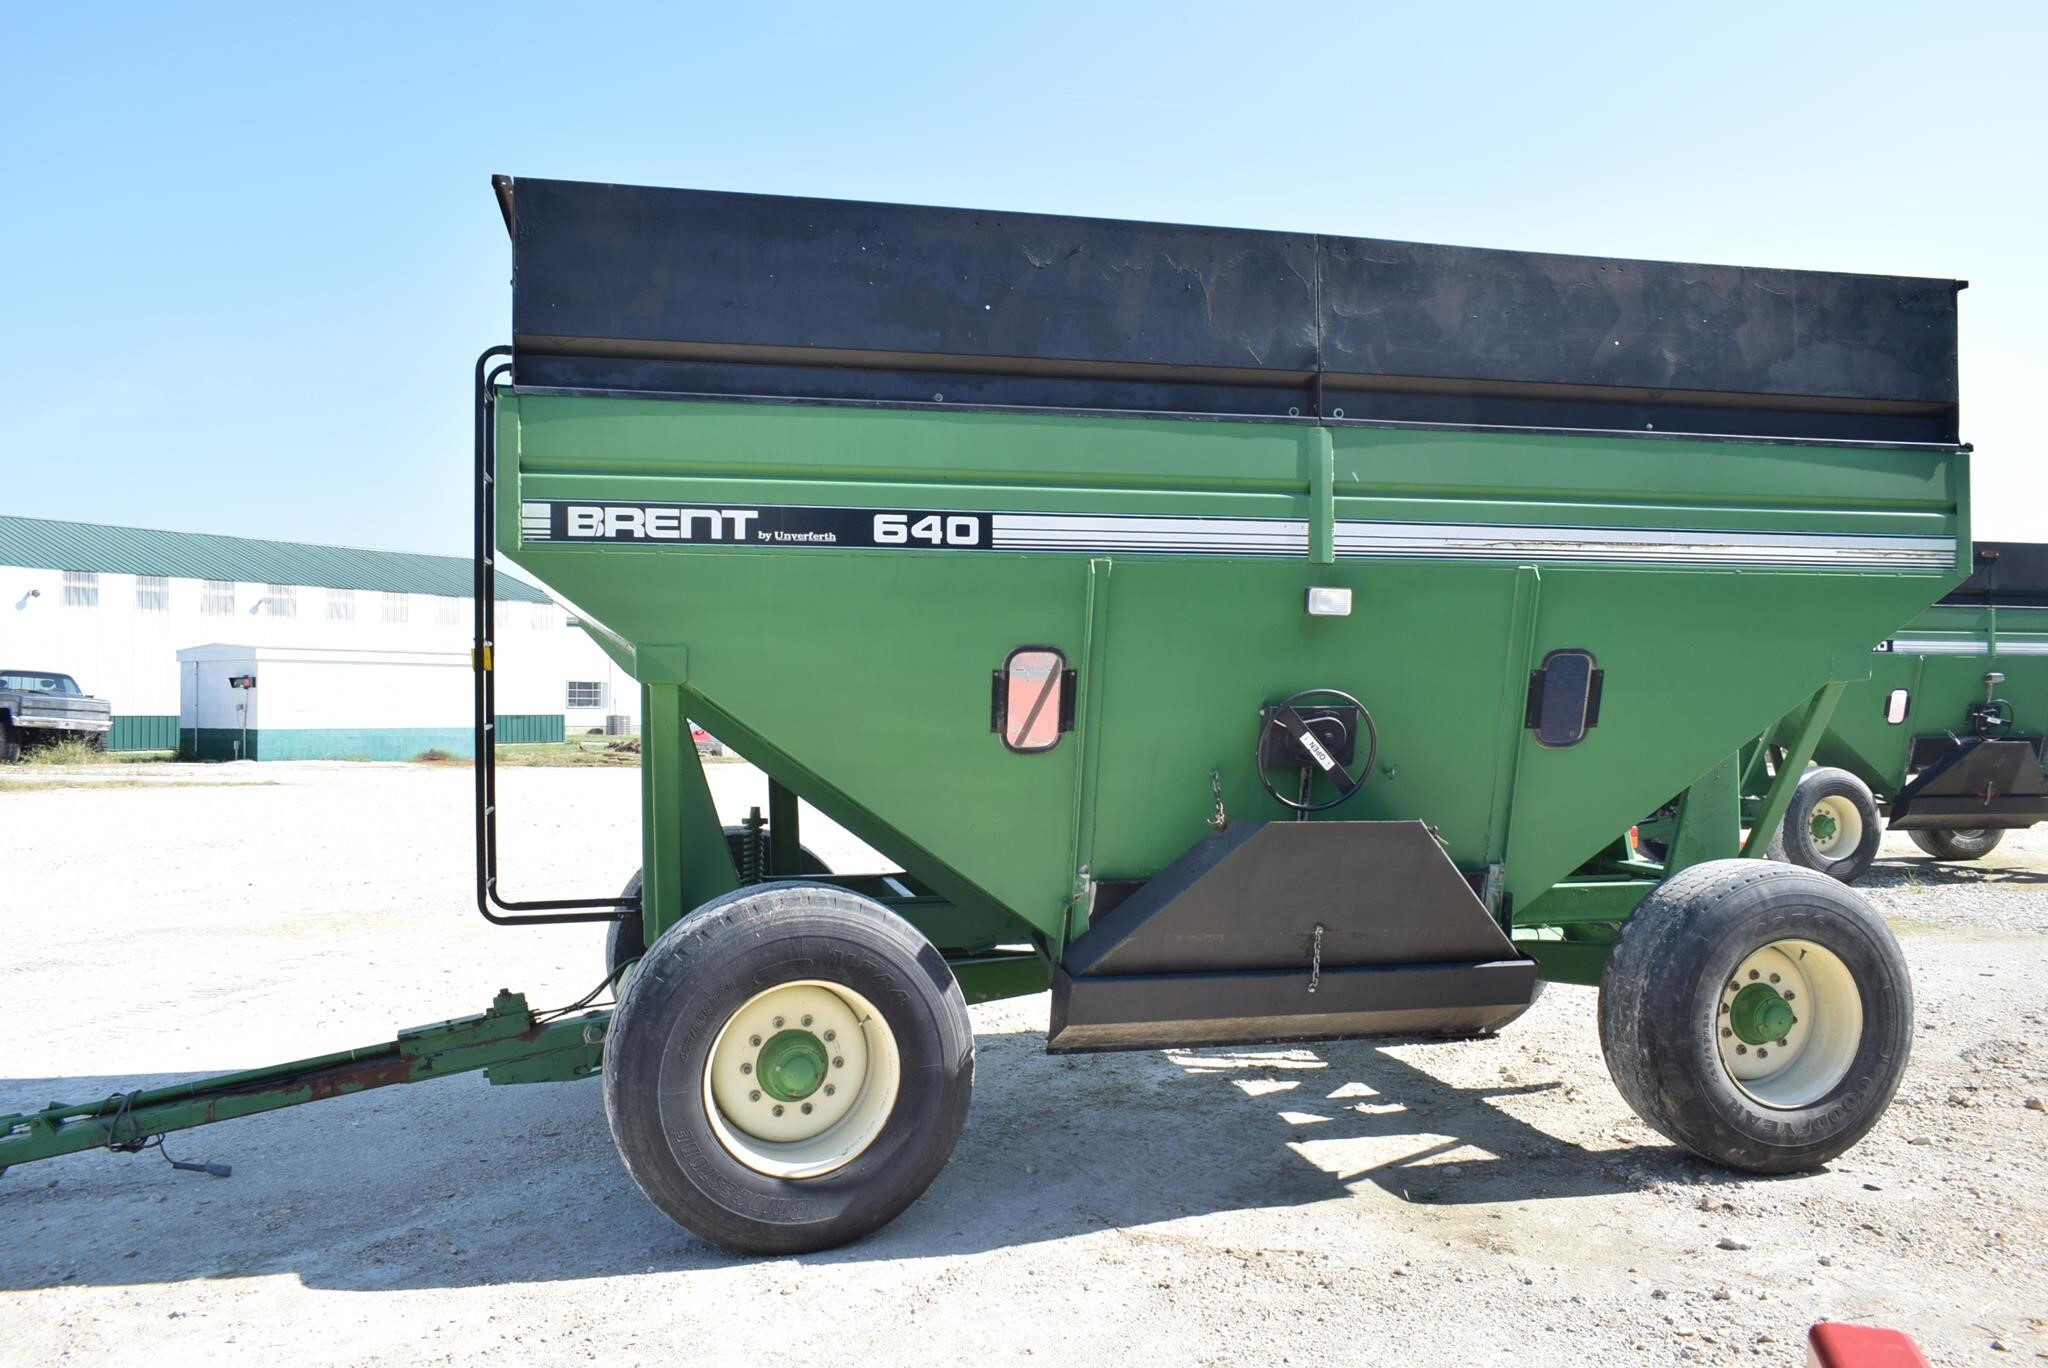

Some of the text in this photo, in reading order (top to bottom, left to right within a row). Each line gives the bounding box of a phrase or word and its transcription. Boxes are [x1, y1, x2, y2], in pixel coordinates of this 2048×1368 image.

[567, 506, 759, 540] BRENT
[758, 530, 837, 543] by Unverferth
[873, 513, 980, 545] 640
[1309, 741, 1326, 761] OPEN
[1727, 1076, 1873, 1136] GOODYEAR
[671, 1126, 811, 1221] BRIDGESTONE
